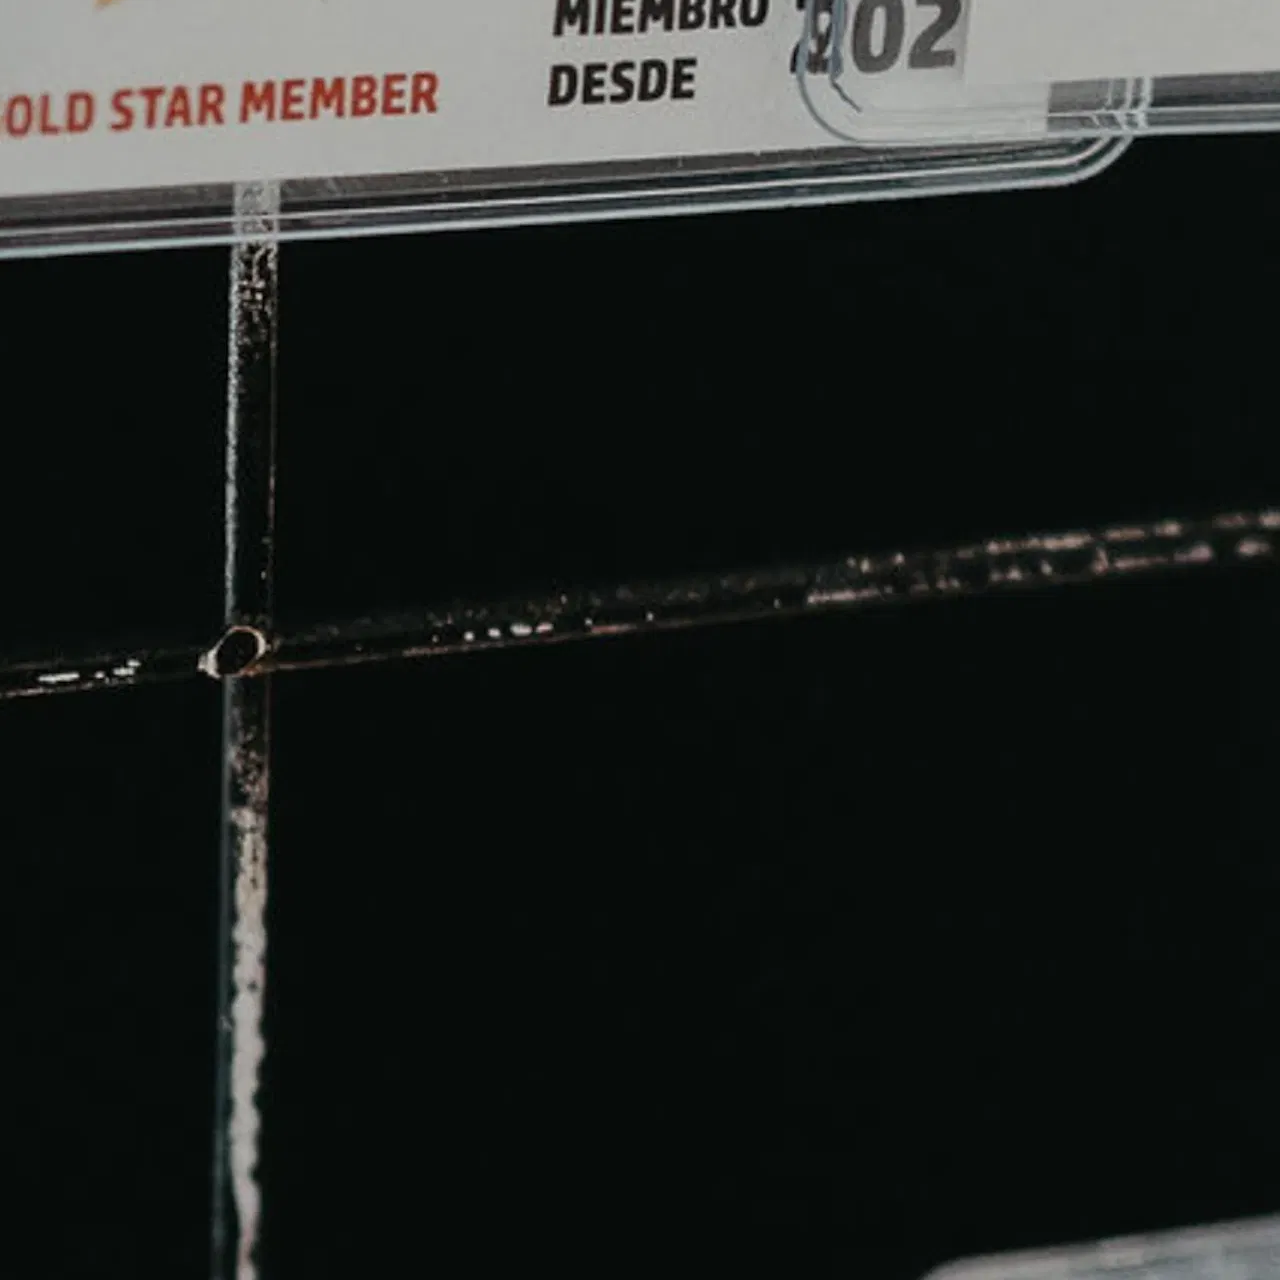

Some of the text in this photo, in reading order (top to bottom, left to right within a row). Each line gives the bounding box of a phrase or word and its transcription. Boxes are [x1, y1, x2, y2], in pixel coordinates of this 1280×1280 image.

[110, 81, 227, 133] STAR
[239, 70, 440, 123] MEMBER
[546, 56, 699, 108] DESDE
